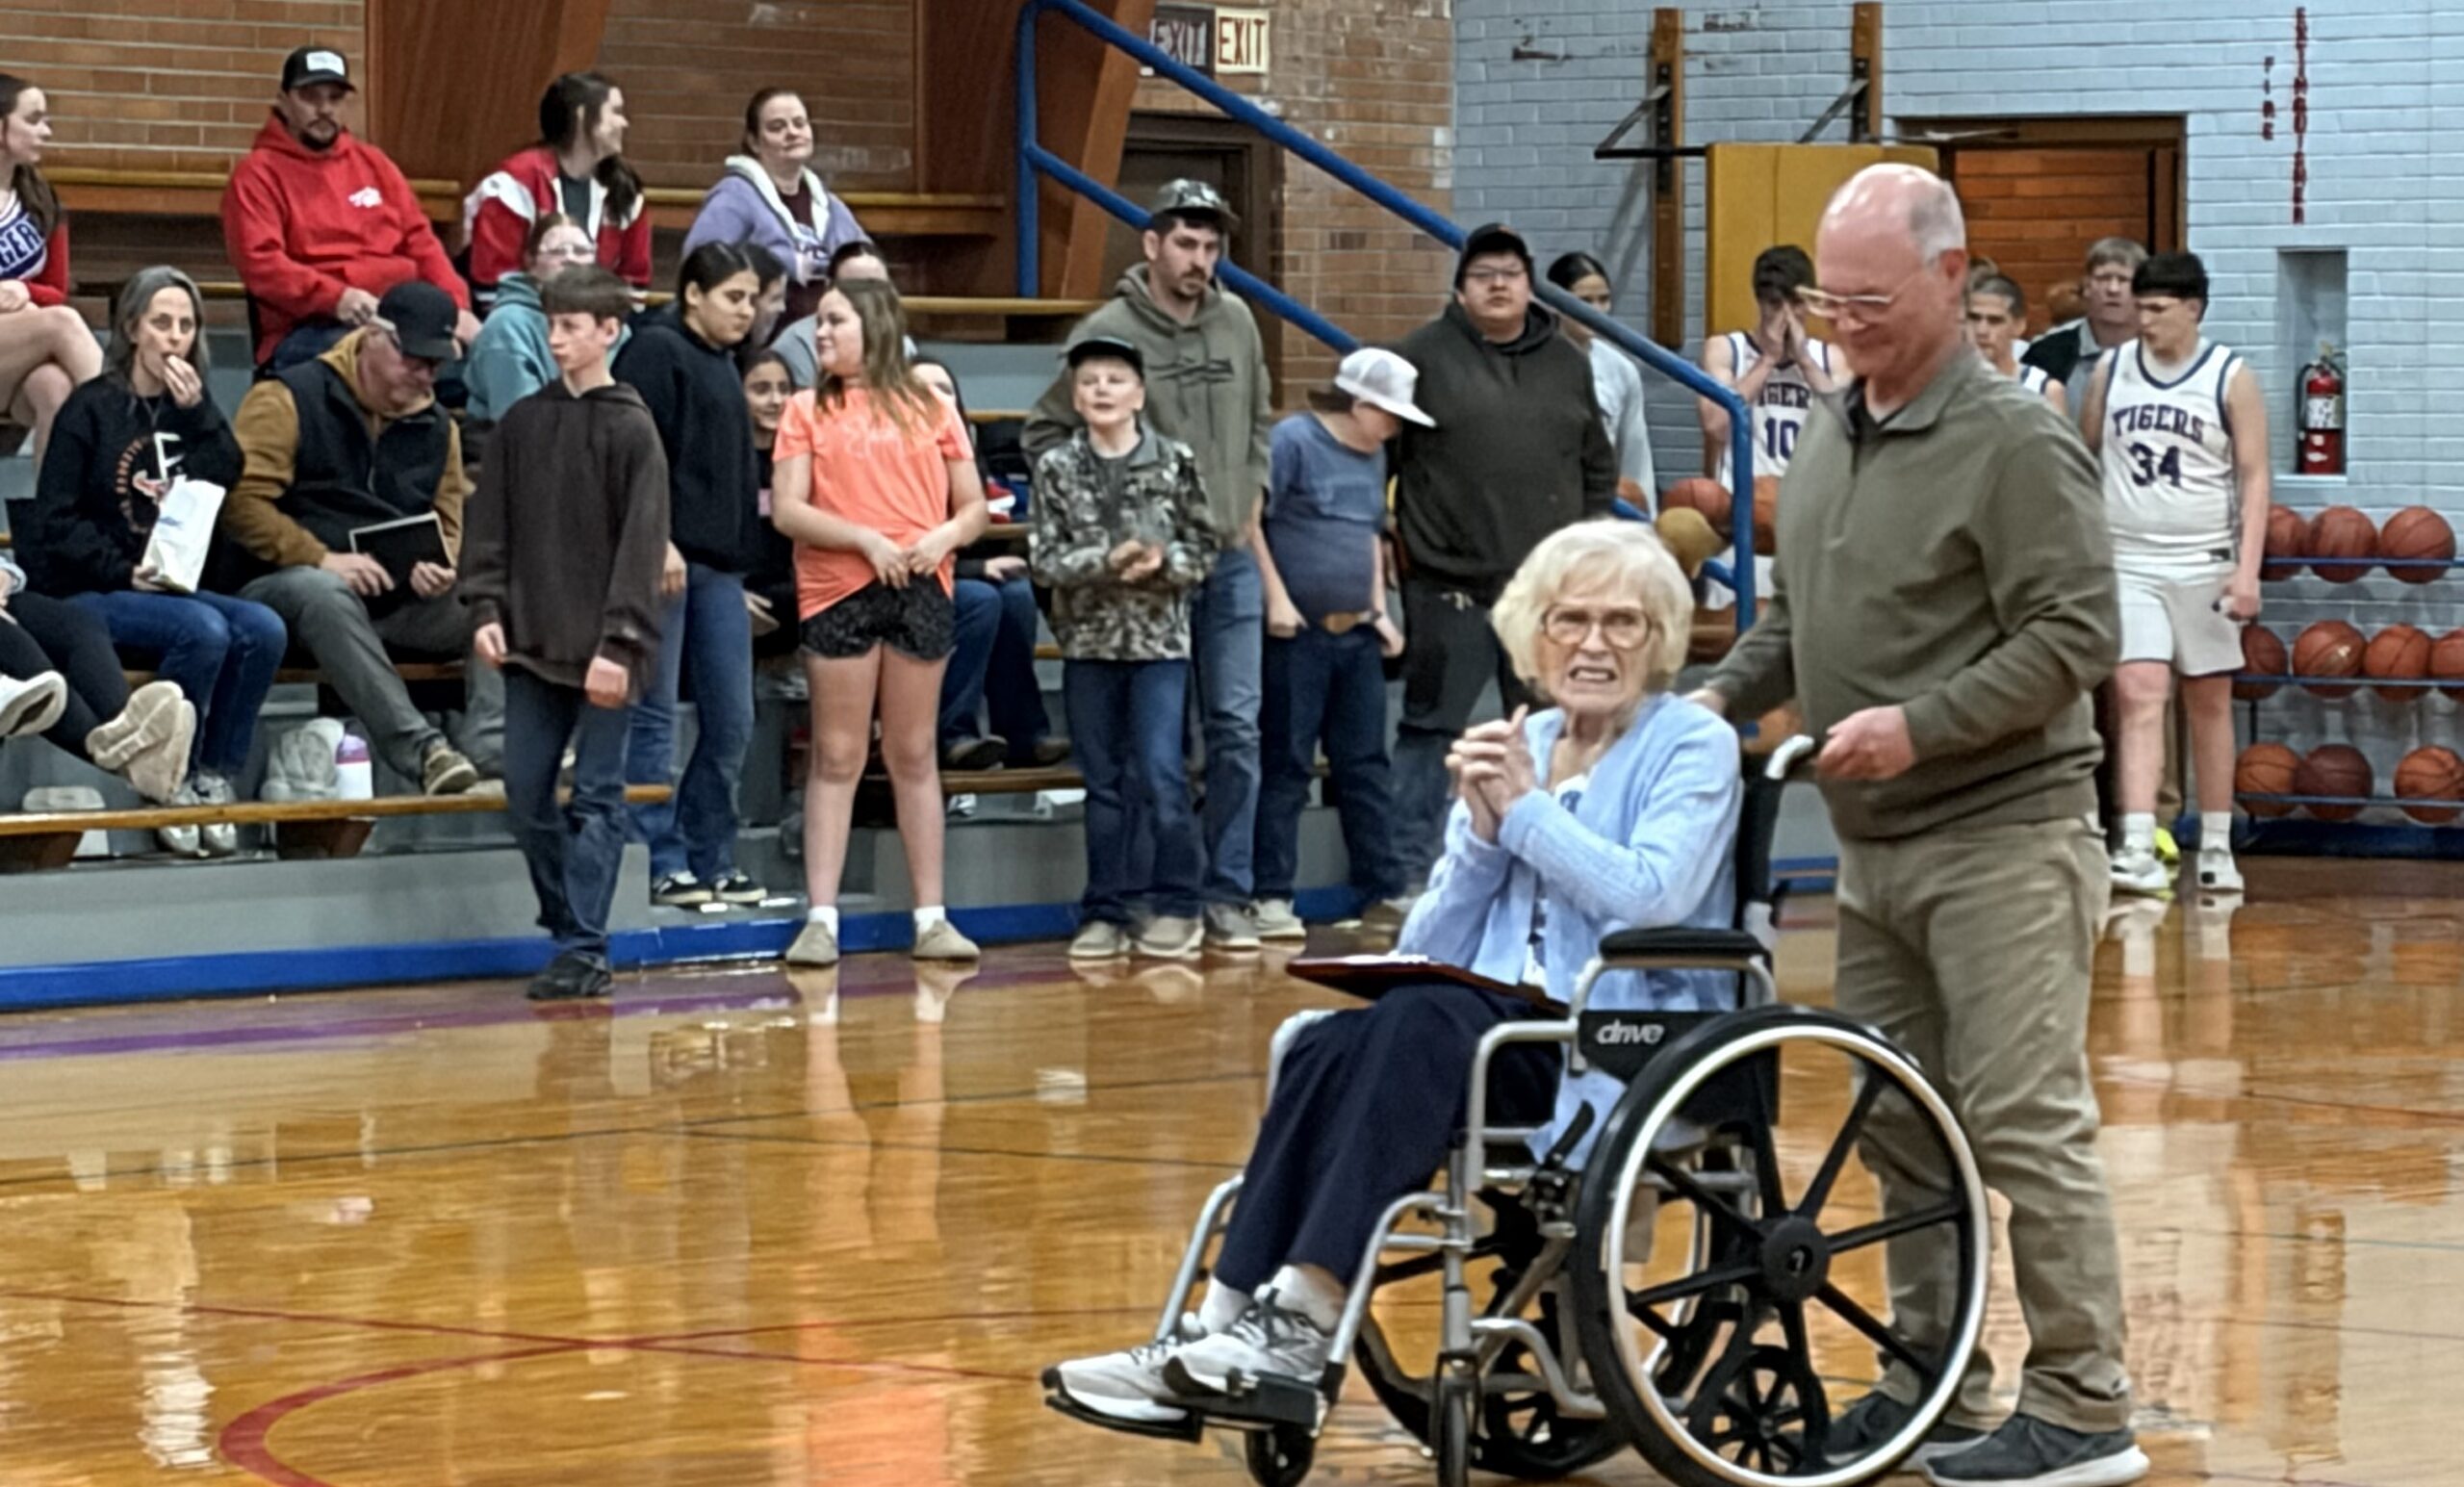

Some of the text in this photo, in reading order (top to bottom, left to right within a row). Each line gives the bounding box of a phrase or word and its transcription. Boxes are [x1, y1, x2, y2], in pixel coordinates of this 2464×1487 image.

[1218, 16, 1266, 65] EXIT
[2263, 56, 2274, 141] FIRE
[1764, 417, 1800, 460] 10
[2113, 402, 2204, 447] TIGERS
[2128, 442, 2181, 488] 34
[1596, 1019, 1664, 1044] drive
